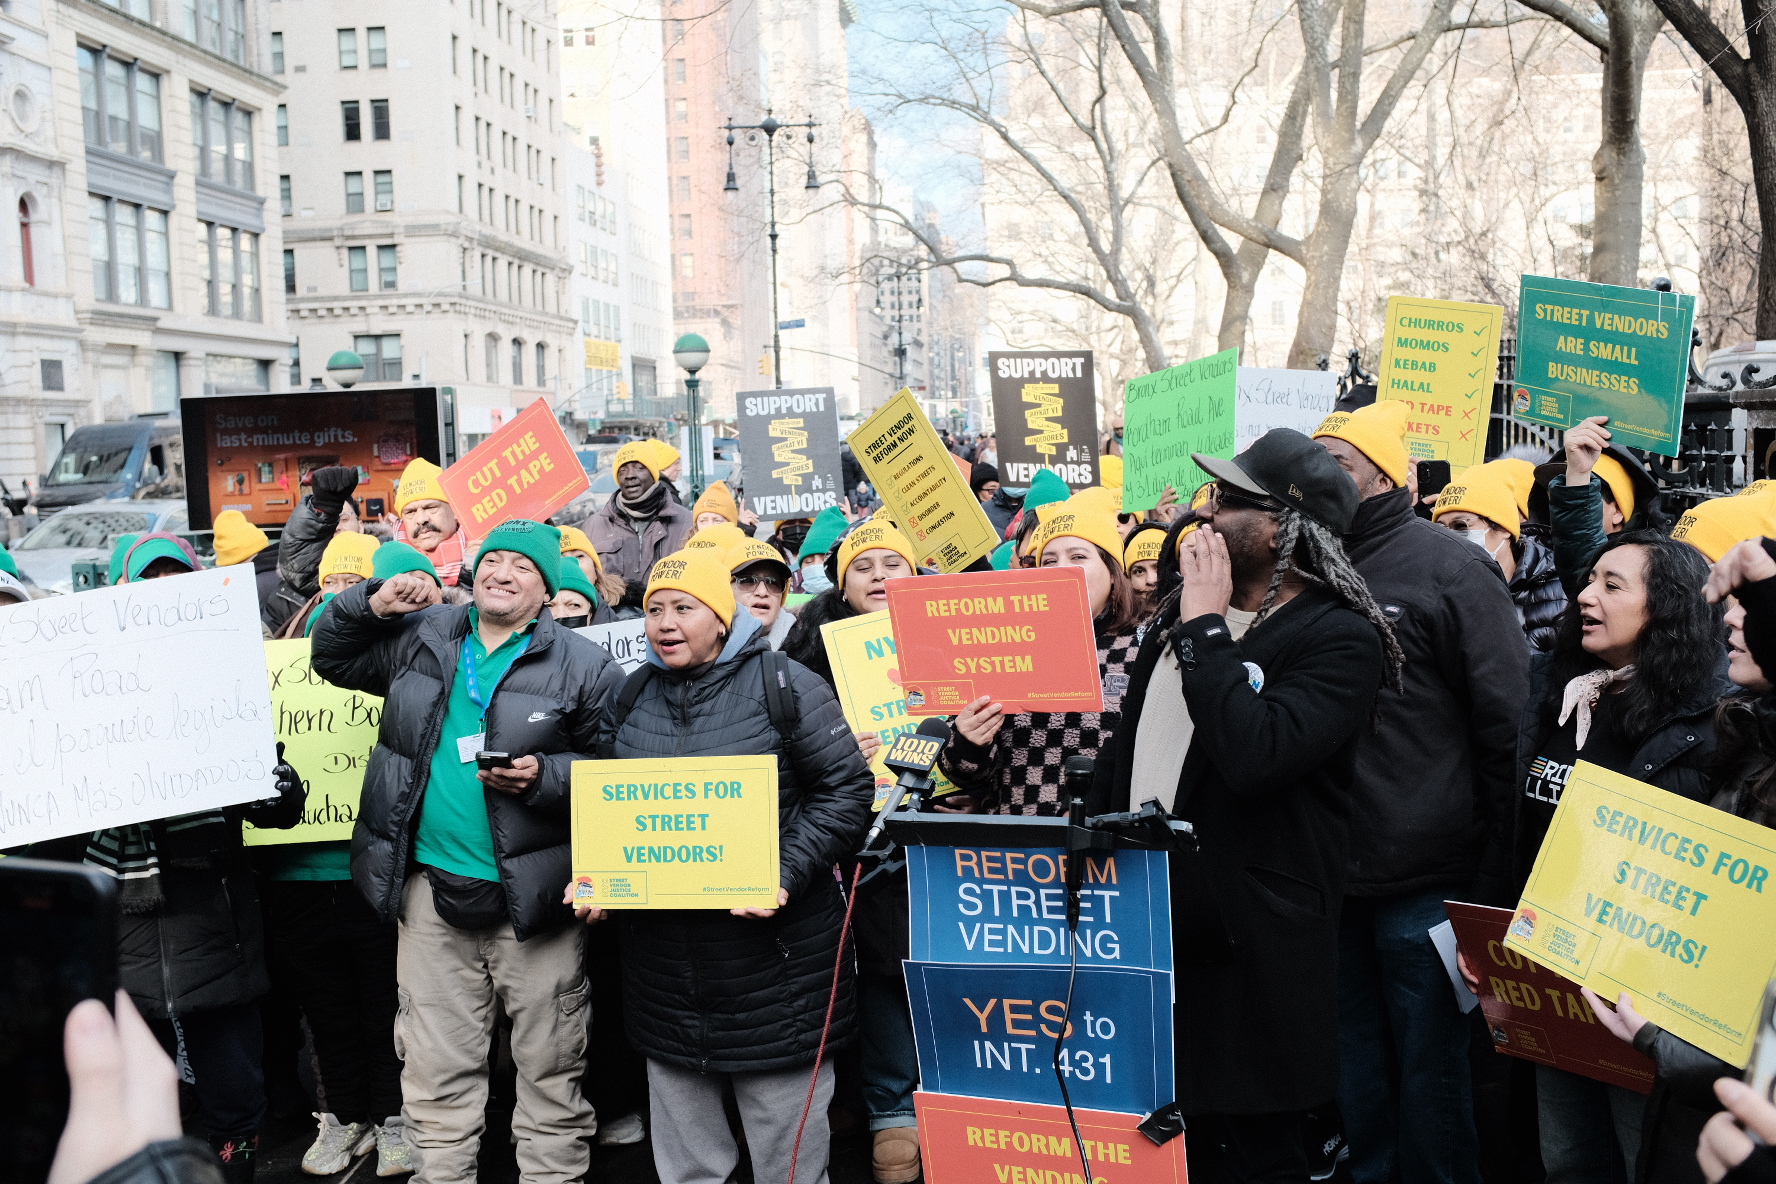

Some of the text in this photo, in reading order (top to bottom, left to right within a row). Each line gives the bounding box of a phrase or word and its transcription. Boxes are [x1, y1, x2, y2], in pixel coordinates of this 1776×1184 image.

[1399, 316, 1465, 333] CHURROS
[1535, 303, 1669, 339] STREET VENDORS
[1396, 336, 1450, 353] MOMOS
[1556, 335, 1639, 365] ARE SMALL
[997, 357, 1084, 378] SUPPORT
[1394, 358, 1437, 373] KEBAB
[1127, 356, 1233, 403] Bronx Street Vendors
[1391, 378, 1433, 393] HALAL
[1548, 361, 1639, 394] BUSINESSES
[1255, 377, 1291, 407] Street
[1541, 395, 1557, 403] STREET
[745, 393, 826, 417] SUPPORT
[1175, 396, 1204, 429] Road
[1208, 395, 1225, 423] Ave
[1419, 402, 1452, 417] TAPE
[1540, 410, 1564, 419] COALITION
[215, 413, 278, 428] Save on
[1406, 421, 1441, 436] KETS
[1614, 420, 1671, 438] #StreetVendorReform
[216, 427, 358, 447] last-minute gifts.
[864, 412, 914, 457] STREET VENDOR
[872, 423, 918, 465] REFORM NOW!
[1409, 446, 1435, 454] VENDOR
[467, 431, 540, 494] CUT THE
[893, 454, 924, 481] REGULATIONS
[402, 478, 426, 491] VENDOR
[470, 451, 556, 524] RED TAPE
[901, 464, 936, 494] CLEAN STREETS
[402, 486, 426, 499] POWER!
[909, 476, 947, 508] ACCOUNTABILITY
[753, 491, 837, 516] VENDORS
[917, 501, 941, 522] DISORDER
[925, 510, 956, 536] CONGESTION
[1041, 523, 1074, 543] POWER!
[1042, 514, 1076, 533] VENDOR
[850, 527, 884, 542] VENDOR
[850, 534, 884, 551] POWER!
[1137, 542, 1162, 550] VENDO
[1137, 549, 1161, 559] POWE
[332, 564, 362, 573] POWER!
[334, 555, 363, 564] VENDOR
[653, 560, 688, 574] VENDOR
[650, 569, 683, 583] POWER!
[925, 593, 1050, 617] REFORM THE
[9, 592, 230, 644] Street Vendors
[601, 631, 647, 659] dors
[947, 625, 1036, 646] VENDING
[864, 635, 896, 661] NY
[953, 655, 1034, 675] SYSTEM
[58, 651, 152, 701] Road
[1027, 691, 1093, 699] #StreetVendorReform
[279, 694, 381, 736] hern Bo
[531, 711, 546, 719] NIKE
[869, 699, 908, 722] STR
[895, 736, 941, 754] 1010
[889, 748, 935, 767] WINS
[602, 780, 743, 802] SERVICES FOR
[635, 813, 710, 832] STREET
[622, 844, 725, 864] VENDORS!
[1592, 804, 1769, 894] SERVICES FOR
[1613, 860, 1709, 917] STREET
[957, 882, 1120, 923] STREET
[957, 921, 1120, 960] VENDING
[1552, 932, 1578, 948] VENDOR
[1554, 926, 1577, 941] STREET
[1583, 892, 1708, 969] VENDORS!
[1547, 945, 1581, 966] COALITION
[1548, 939, 1575, 956] JUSTICE
[1488, 976, 1541, 1011] RED
[961, 997, 1116, 1040] YES to
[1656, 991, 1743, 1040] #StreetVendorReform
[973, 1039, 1112, 1084] INT. 431
[966, 1125, 1132, 1165] REFORM THE
[1322, 1132, 1342, 1156] HOKA
